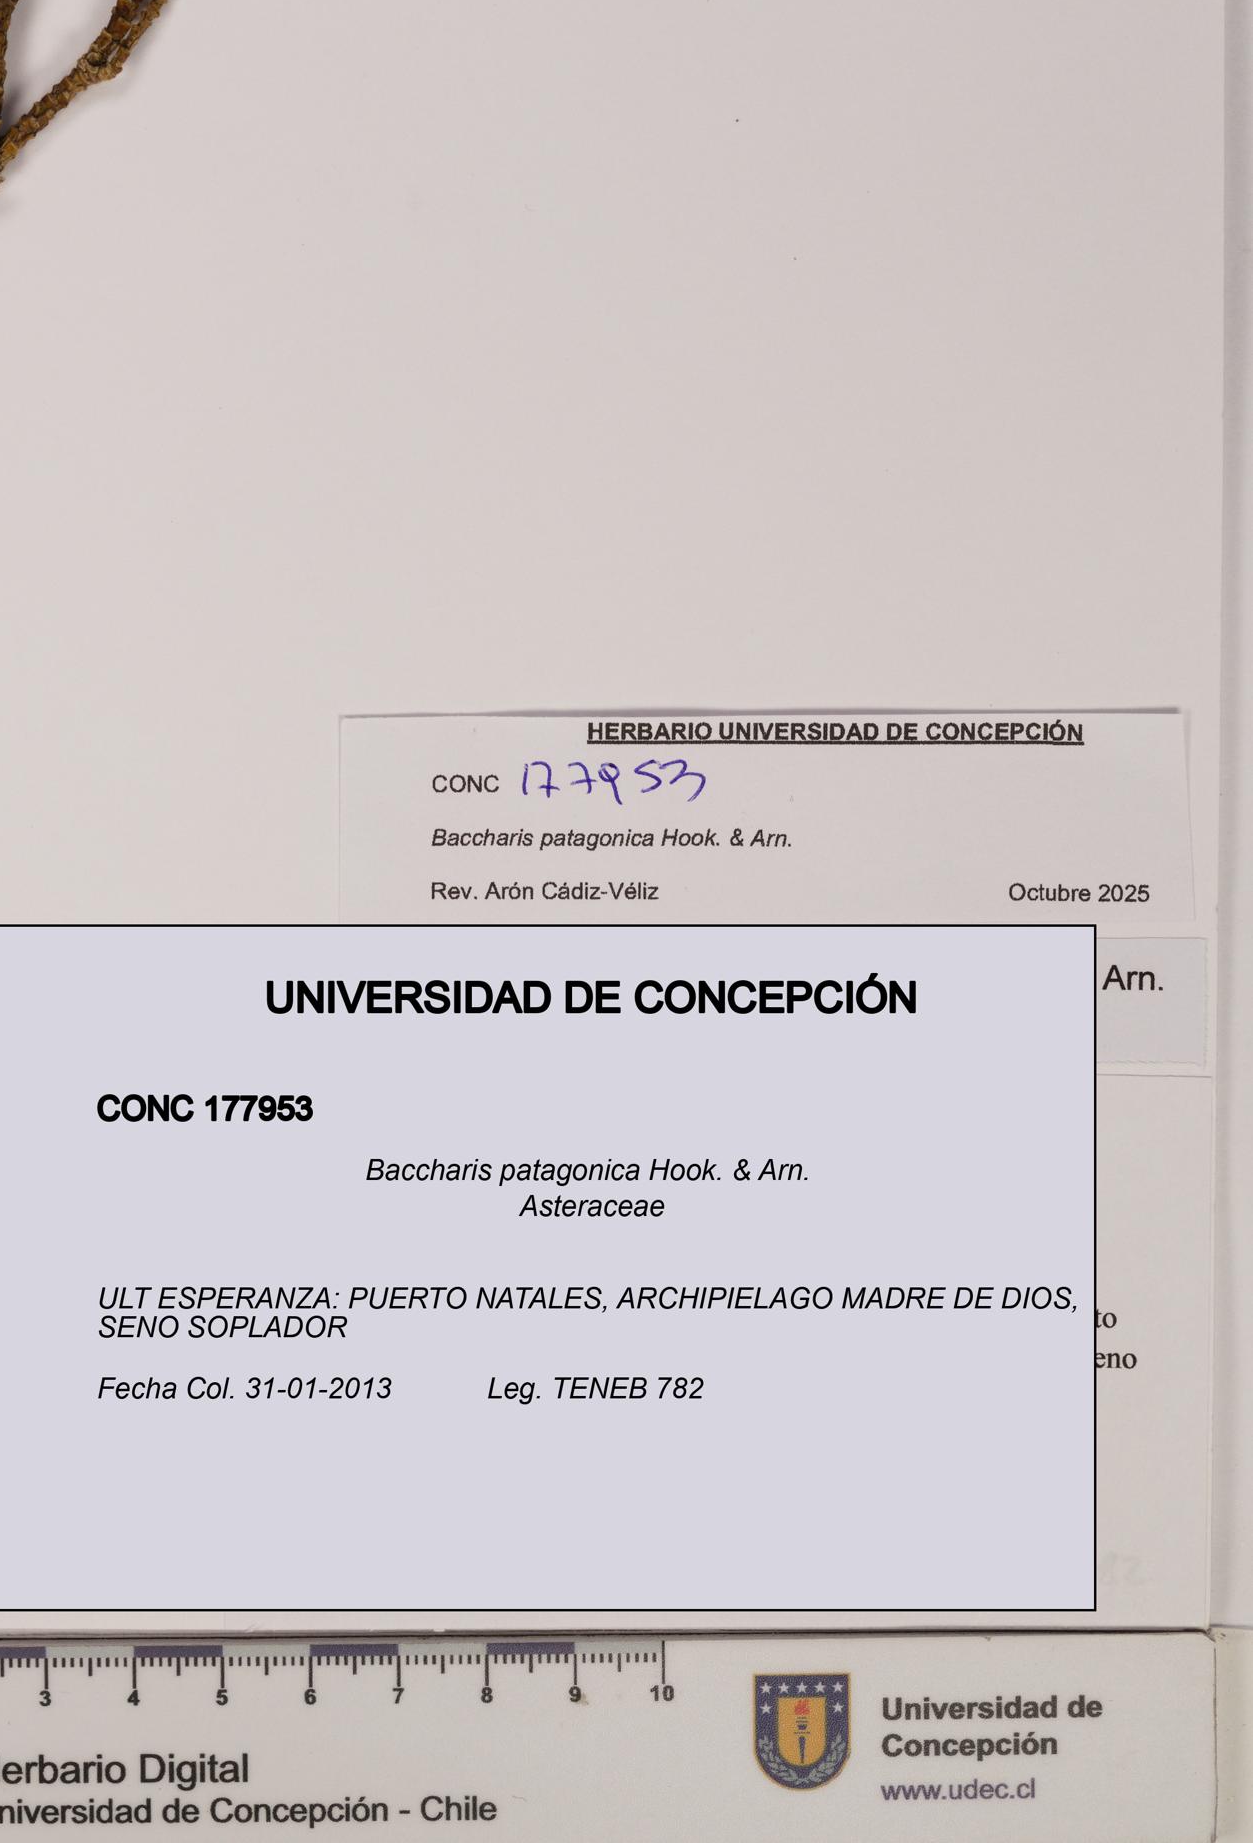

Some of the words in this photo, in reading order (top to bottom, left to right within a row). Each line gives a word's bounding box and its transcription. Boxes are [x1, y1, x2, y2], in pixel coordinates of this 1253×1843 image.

[587, 721, 714, 745] HERBARIO
[717, 721, 880, 745] UNIVERSIDAD
[885, 722, 919, 746] DE
[924, 718, 1086, 747] CONCEPCIÓN
[432, 773, 500, 794] CONC
[521, 758, 707, 806] 177953
[431, 828, 534, 847] Baccharis
[539, 828, 655, 852] patagonica
[660, 828, 720, 847] Hook.
[729, 827, 744, 847] &
[749, 828, 792, 848] Arn.
[431, 881, 478, 900] Rev.
[484, 881, 534, 901] Arón
[541, 881, 660, 901] Cádiz-Véliz
[1008, 882, 1092, 903] Octubre
[1097, 883, 1150, 903] 2025
[1101, 964, 1164, 991] Arn.
[1096, 1352, 1137, 1369] eno
[38, 1689, 52, 1707] 3
[126, 1689, 141, 1707] 4
[215, 1688, 229, 1706] 5
[303, 1688, 317, 1706] 6
[392, 1687, 406, 1705] 7
[480, 1686, 494, 1704] 8
[568, 1685, 583, 1703] 9
[649, 1684, 676, 1702] 10
[882, 1694, 1058, 1721] Universidad
[1067, 1694, 1103, 1719] de
[881, 1731, 1058, 1762] Concepción
[139, 1752, 249, 1789] Digital
[880, 1777, 1036, 1801] www.udec.cl
[161, 1797, 200, 1824] de
[209, 1796, 389, 1829] Concepción
[420, 1795, 498, 1822] Chile
